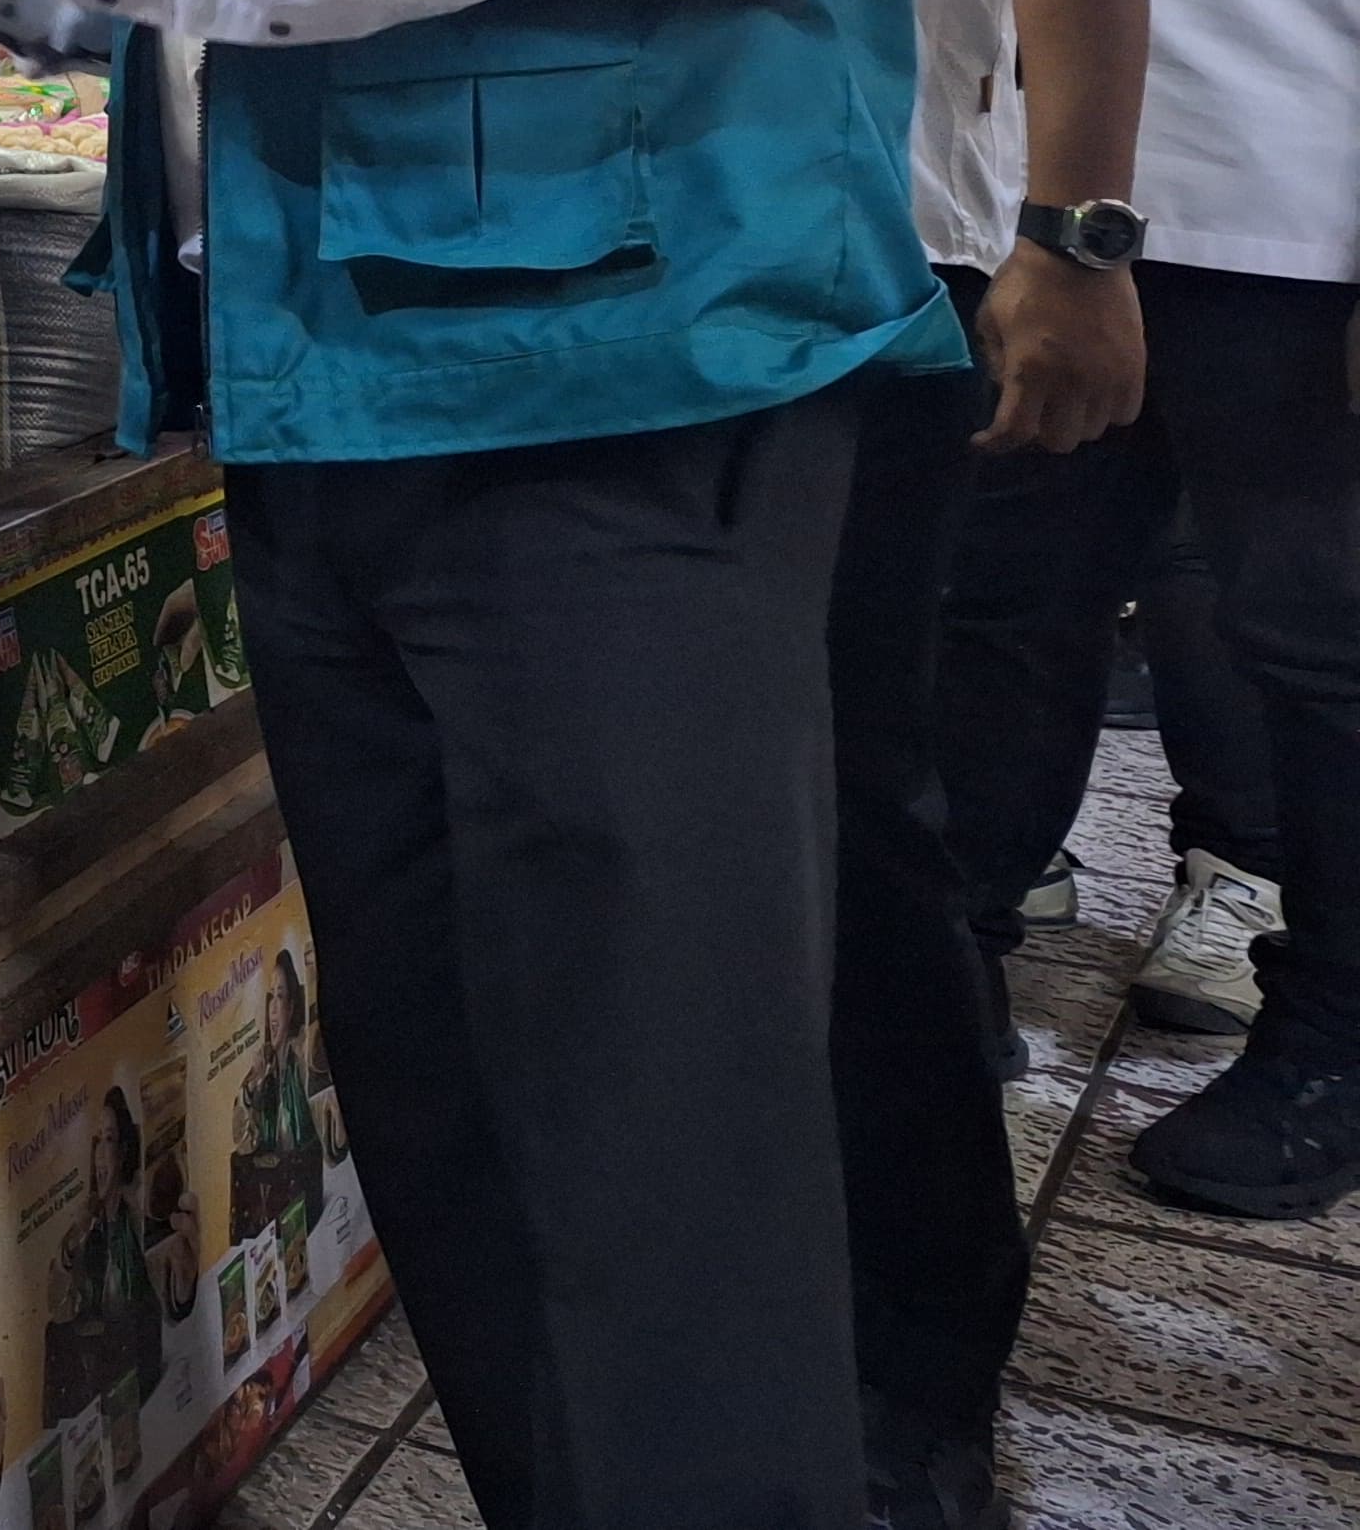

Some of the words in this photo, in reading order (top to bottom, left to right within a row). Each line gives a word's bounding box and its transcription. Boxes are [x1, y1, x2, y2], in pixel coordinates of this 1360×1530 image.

[74, 546, 151, 616] TCA-65
[199, 893, 253, 955] KECAP
[198, 945, 265, 1028] RasaMasa
